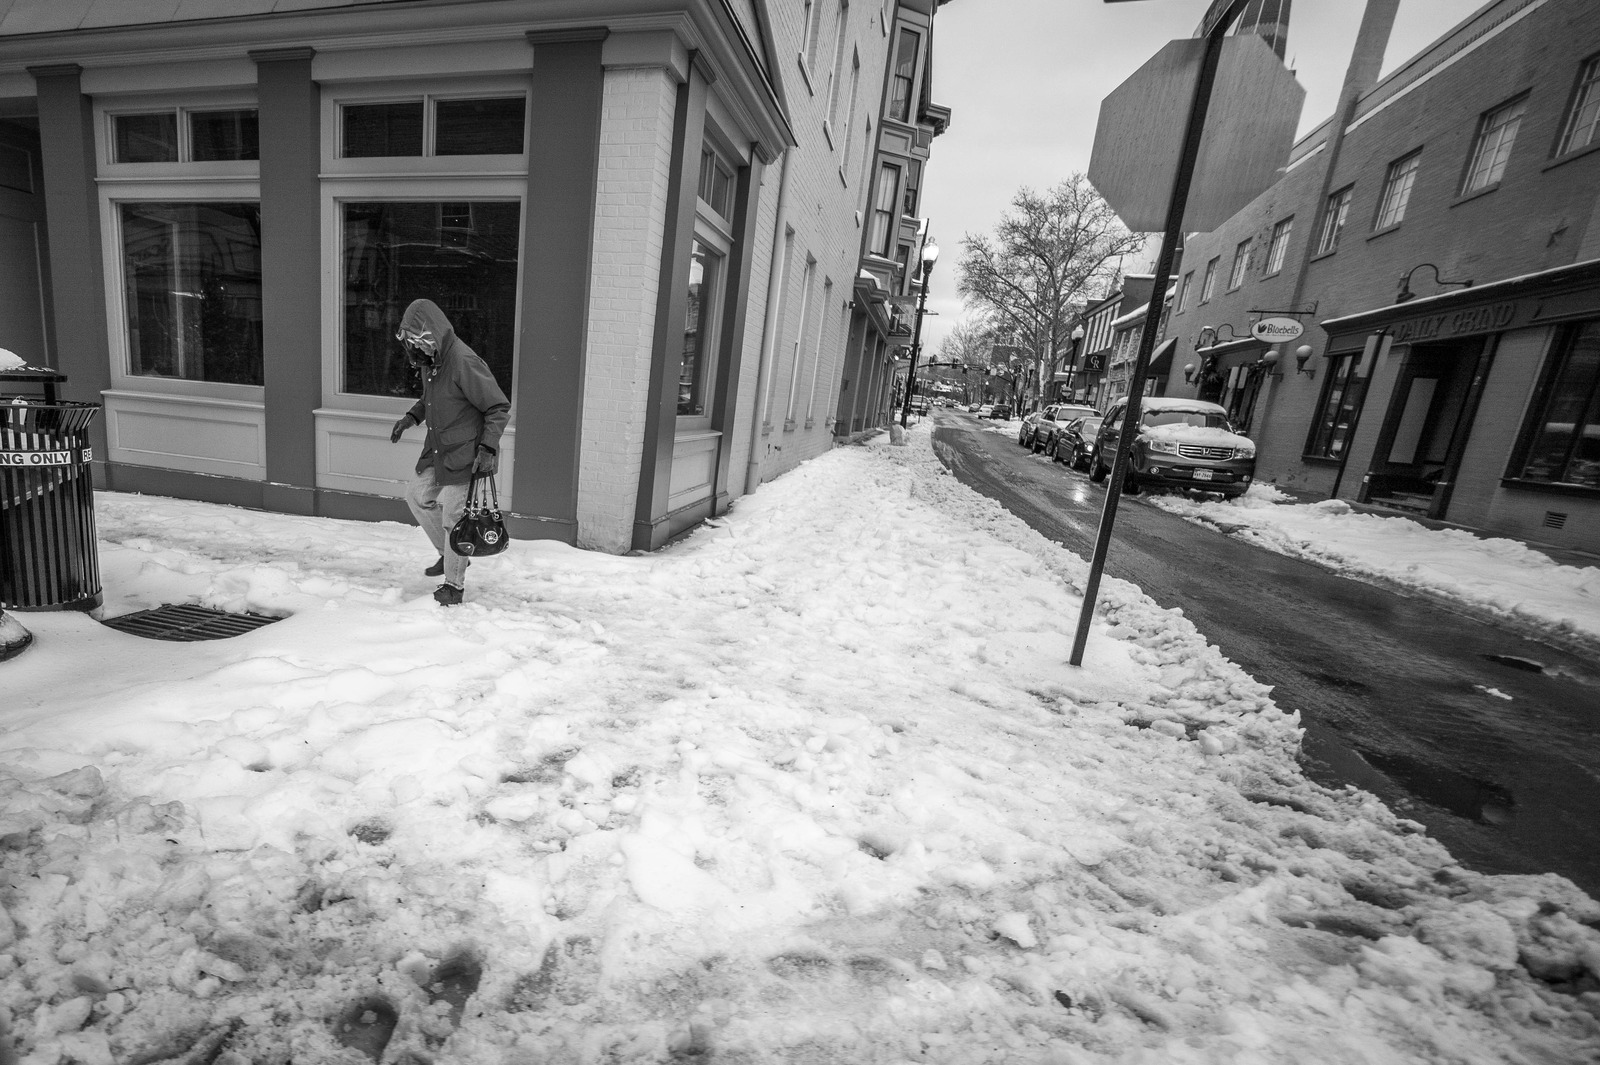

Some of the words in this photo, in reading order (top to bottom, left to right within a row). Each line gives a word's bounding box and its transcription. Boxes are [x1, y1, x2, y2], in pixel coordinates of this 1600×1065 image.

[1394, 315, 1447, 342] DAILY
[1451, 302, 1516, 334] GRIND
[1267, 323, 1299, 334] Bluebells
[30, 453, 68, 464] ONLY
